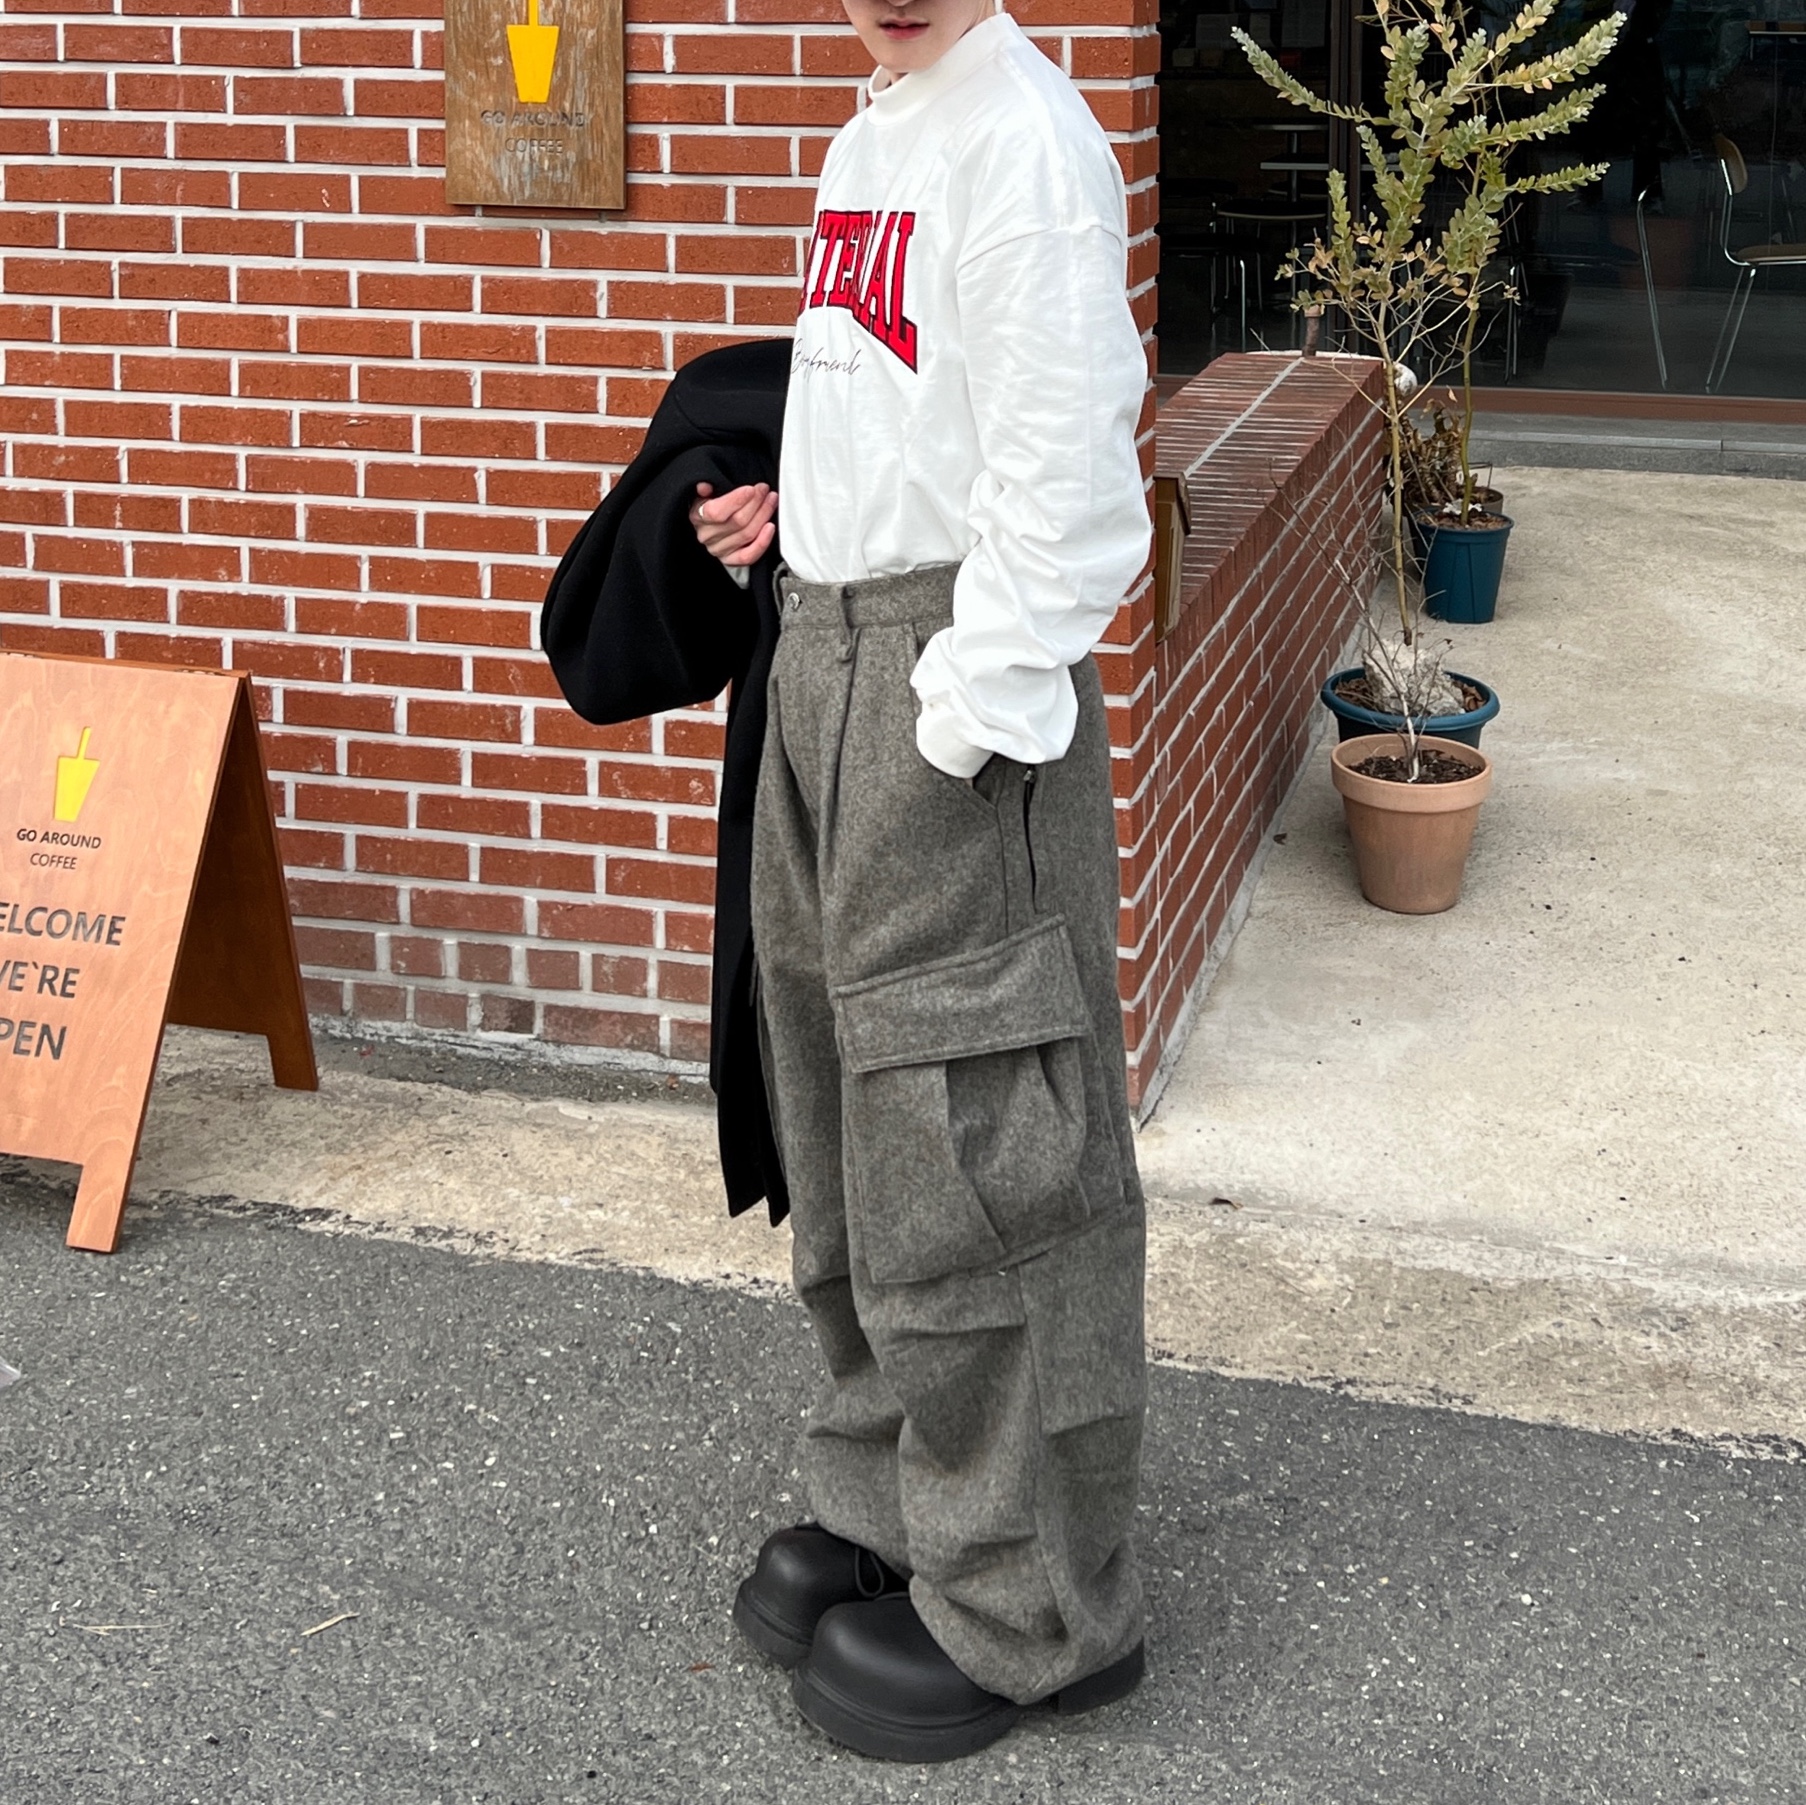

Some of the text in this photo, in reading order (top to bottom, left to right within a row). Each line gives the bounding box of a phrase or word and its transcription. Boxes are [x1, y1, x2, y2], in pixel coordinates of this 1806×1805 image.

[481, 110, 585, 127] GO AROUND
[505, 137, 564, 154] COFFEE
[16, 828, 102, 849] GO AROUND
[30, 852, 78, 870] COFFEE
